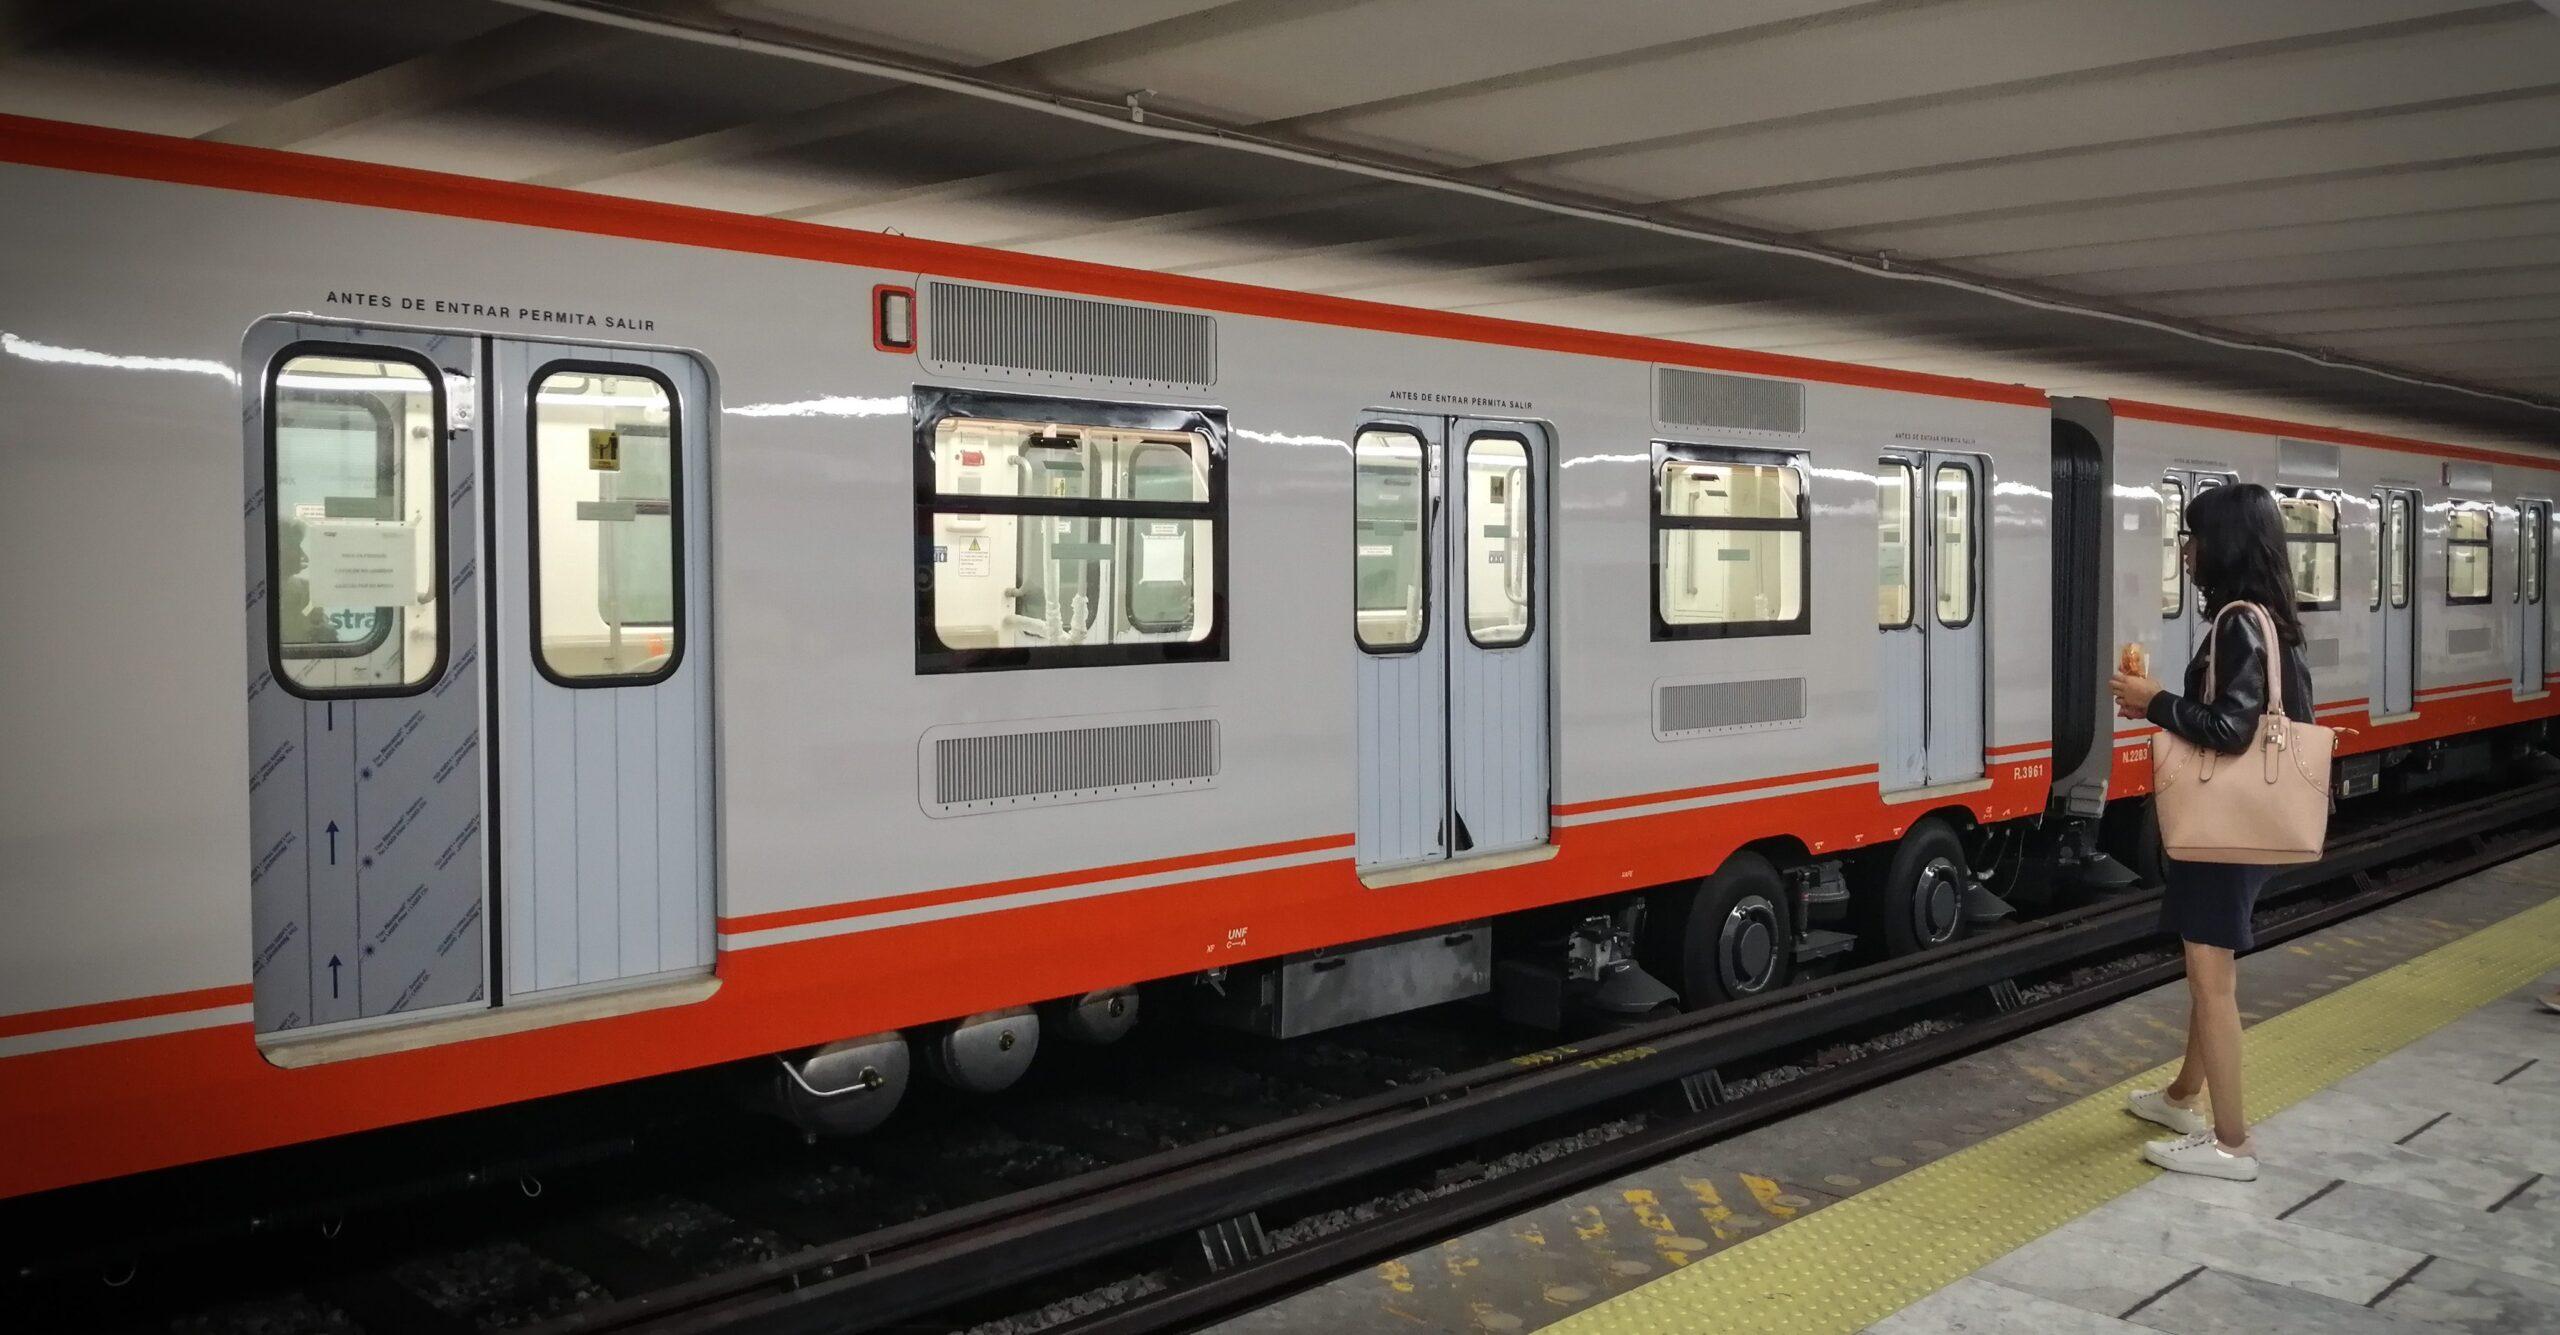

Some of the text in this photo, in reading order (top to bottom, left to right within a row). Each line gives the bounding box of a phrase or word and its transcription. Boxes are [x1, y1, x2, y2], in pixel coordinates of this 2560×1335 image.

[325, 290, 654, 332] ANTES DE ENTRAR PERMITA SALIR
[1389, 390, 1533, 410] ANTES DE ENTRAR PERMITA SALIR
[1228, 926, 1248, 940] UNF
